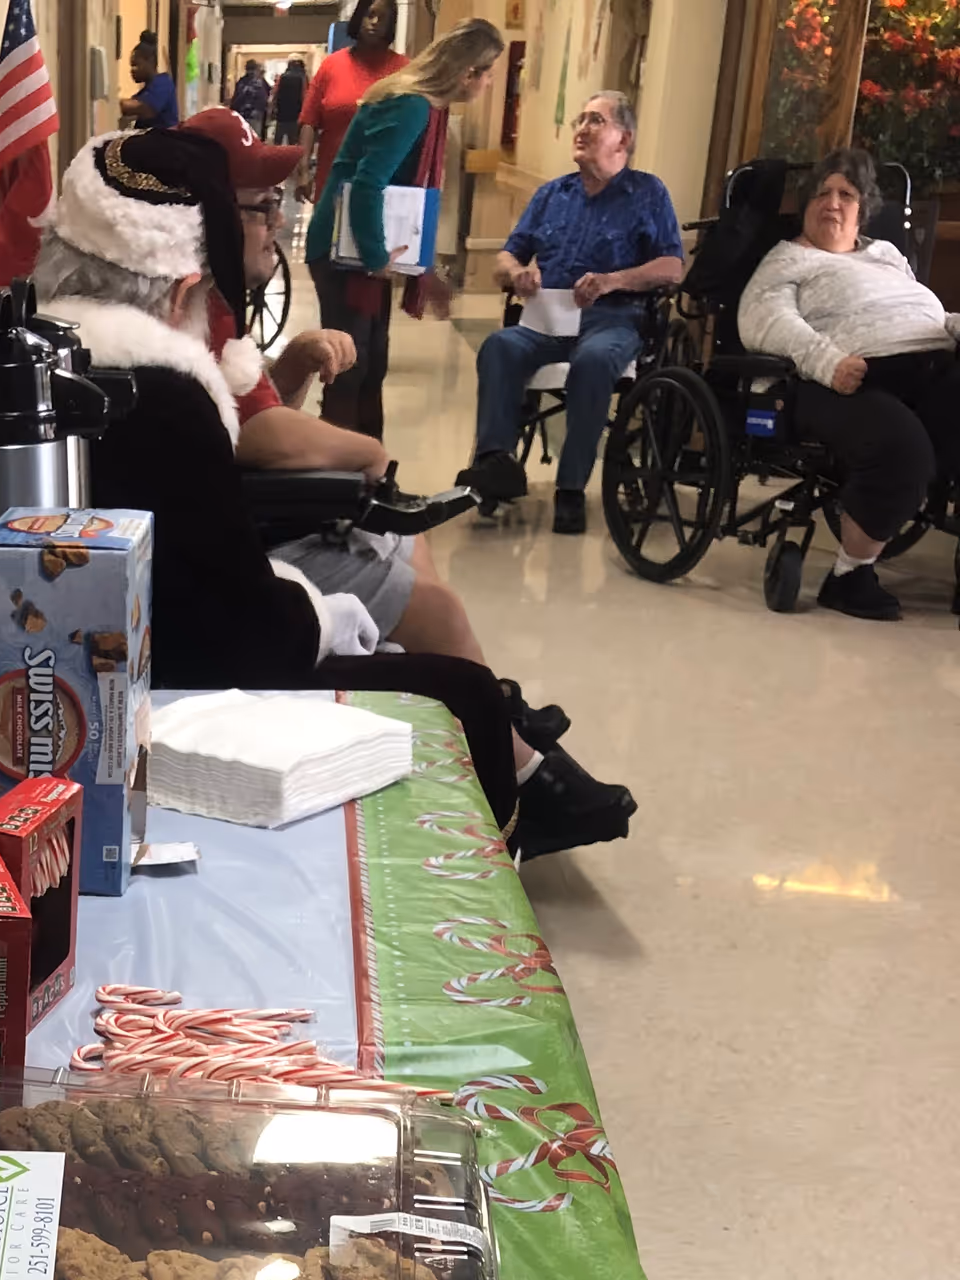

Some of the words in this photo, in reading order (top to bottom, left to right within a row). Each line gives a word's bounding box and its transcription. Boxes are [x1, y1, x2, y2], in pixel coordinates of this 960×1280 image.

[15, 694, 25, 714] MILK
[24, 646, 56, 730] SWISS
[15, 714, 25, 758] CHOCOLATE
[88, 720, 99, 740] 50
[29, 737, 54, 779] MI
[28, 832, 39, 854] 12
[9, 1187, 30, 1232] CARE
[26, 1195, 56, 1276] 251-599-8101
